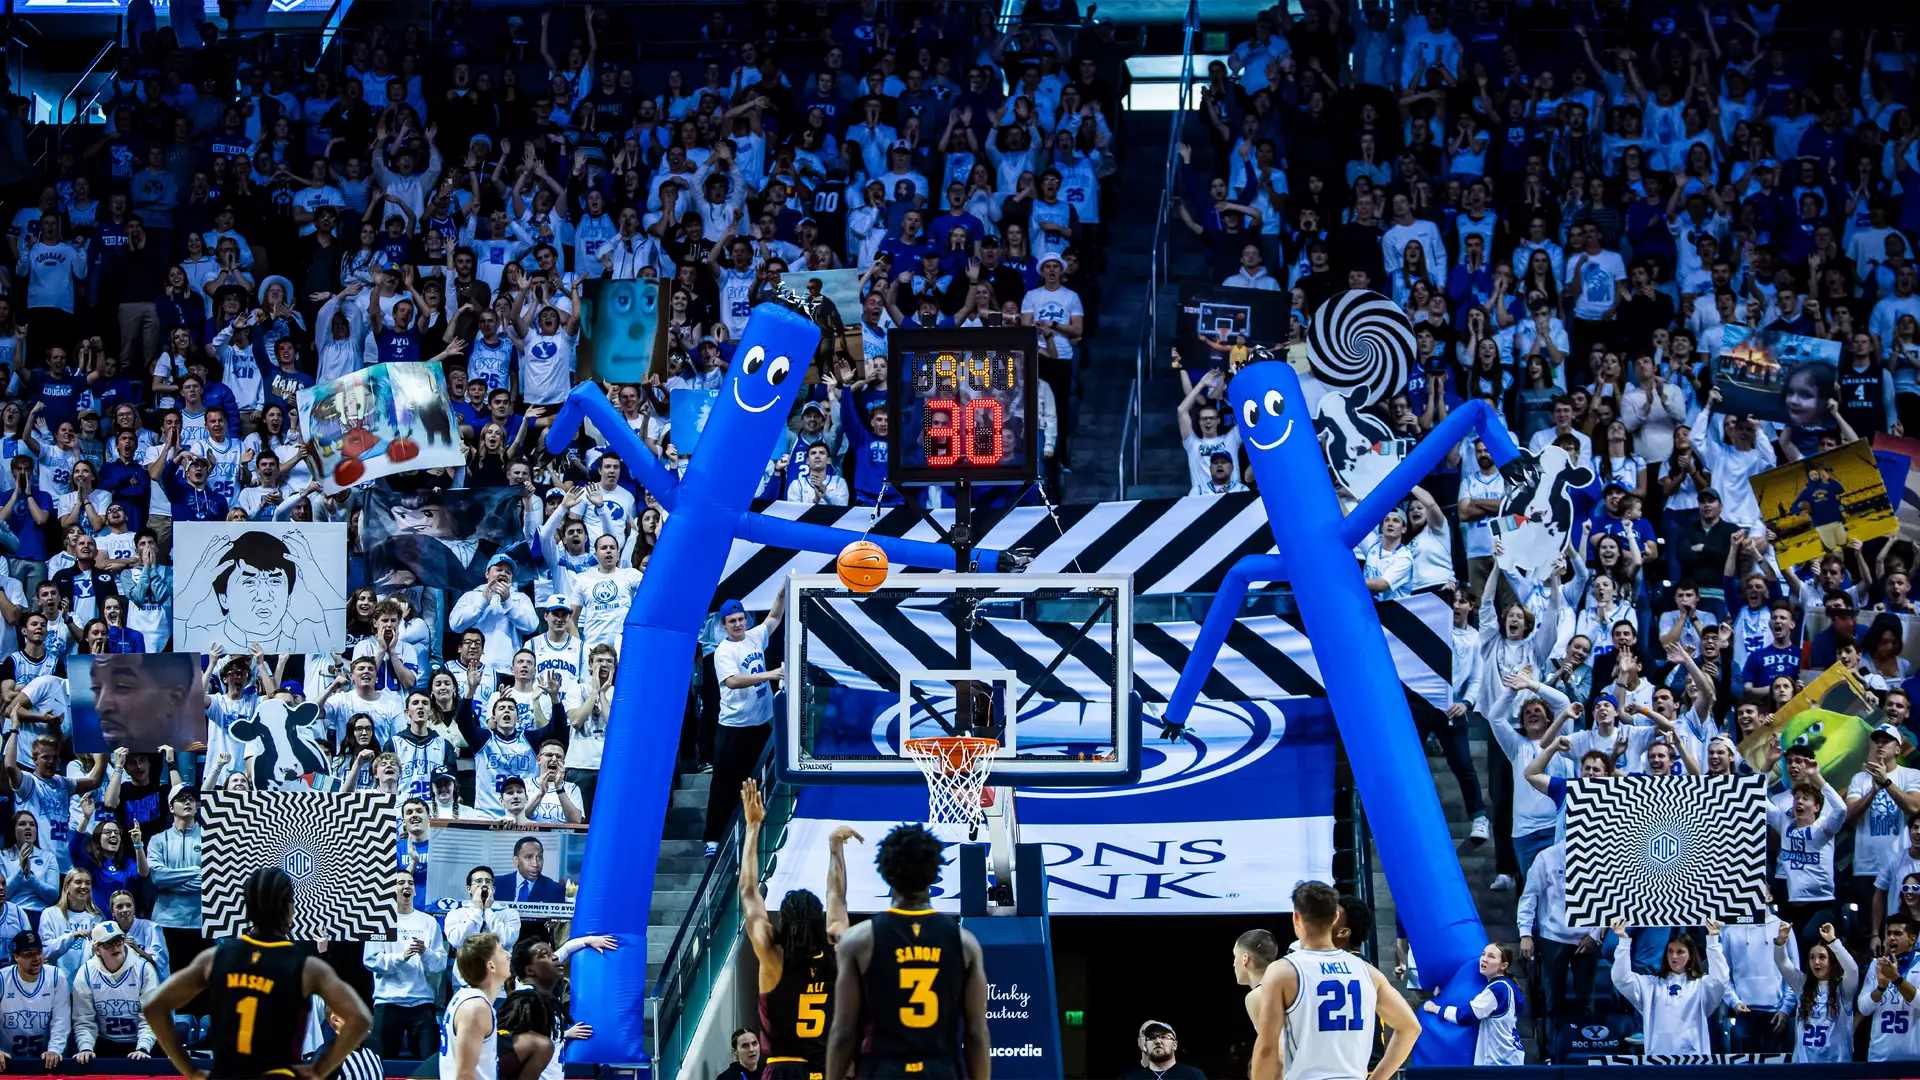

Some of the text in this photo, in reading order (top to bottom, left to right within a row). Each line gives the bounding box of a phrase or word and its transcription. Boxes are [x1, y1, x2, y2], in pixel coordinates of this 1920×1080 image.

[931, 86, 949, 99] Y
[909, 105, 926, 115] Y
[814, 191, 839, 213] 00
[1065, 188, 1083, 202] 25
[36, 251, 66, 264] COUGARS
[1002, 262, 1026, 271] BYU
[732, 302, 751, 317] 25
[536, 342, 554, 359] Y
[935, 354, 1014, 390] 9:41
[1842, 376, 1878, 385] BRIGHAM
[43, 387, 72, 397] COUGARS
[272, 373, 305, 394] RAMS
[1855, 384, 1865, 400] 4
[928, 399, 1004, 465] 30
[53, 469, 70, 485] 23
[214, 480, 234, 498] 25
[75, 579, 93, 598] Y
[537, 658, 577, 676] BRIGHAM
[742, 652, 763, 670] BRIGHAM
[1763, 655, 1800, 667] BYU
[486, 753, 530, 770] BYU
[799, 763, 832, 771] SPALDING
[410, 781, 432, 801] 25
[1870, 817, 1899, 836] HOOPS
[1653, 837, 1676, 856] ROC
[1792, 839, 1803, 851] US
[287, 850, 312, 875] ROC
[1736, 916, 1754, 924] SIREN
[370, 933, 387, 941] SIREN
[1319, 962, 1352, 975] KNELL
[227, 973, 274, 994] MASON
[806, 982, 824, 993] ALI
[899, 968, 939, 1028] 3
[1317, 980, 1364, 1031] 21
[95, 1000, 140, 1016] BYU
[796, 993, 828, 1038] 5
[984, 1008, 1029, 1019] outure
[4, 1010, 52, 1029] BYU
[106, 1018, 138, 1035] 25
[236, 996, 258, 1055] 1
[1881, 1011, 1909, 1034] 25
[1592, 1040, 1619, 1048] BOARD
[1803, 1024, 1829, 1047] 25
[12, 1034, 44, 1056] 25
[988, 1044, 1042, 1057] ucordia
